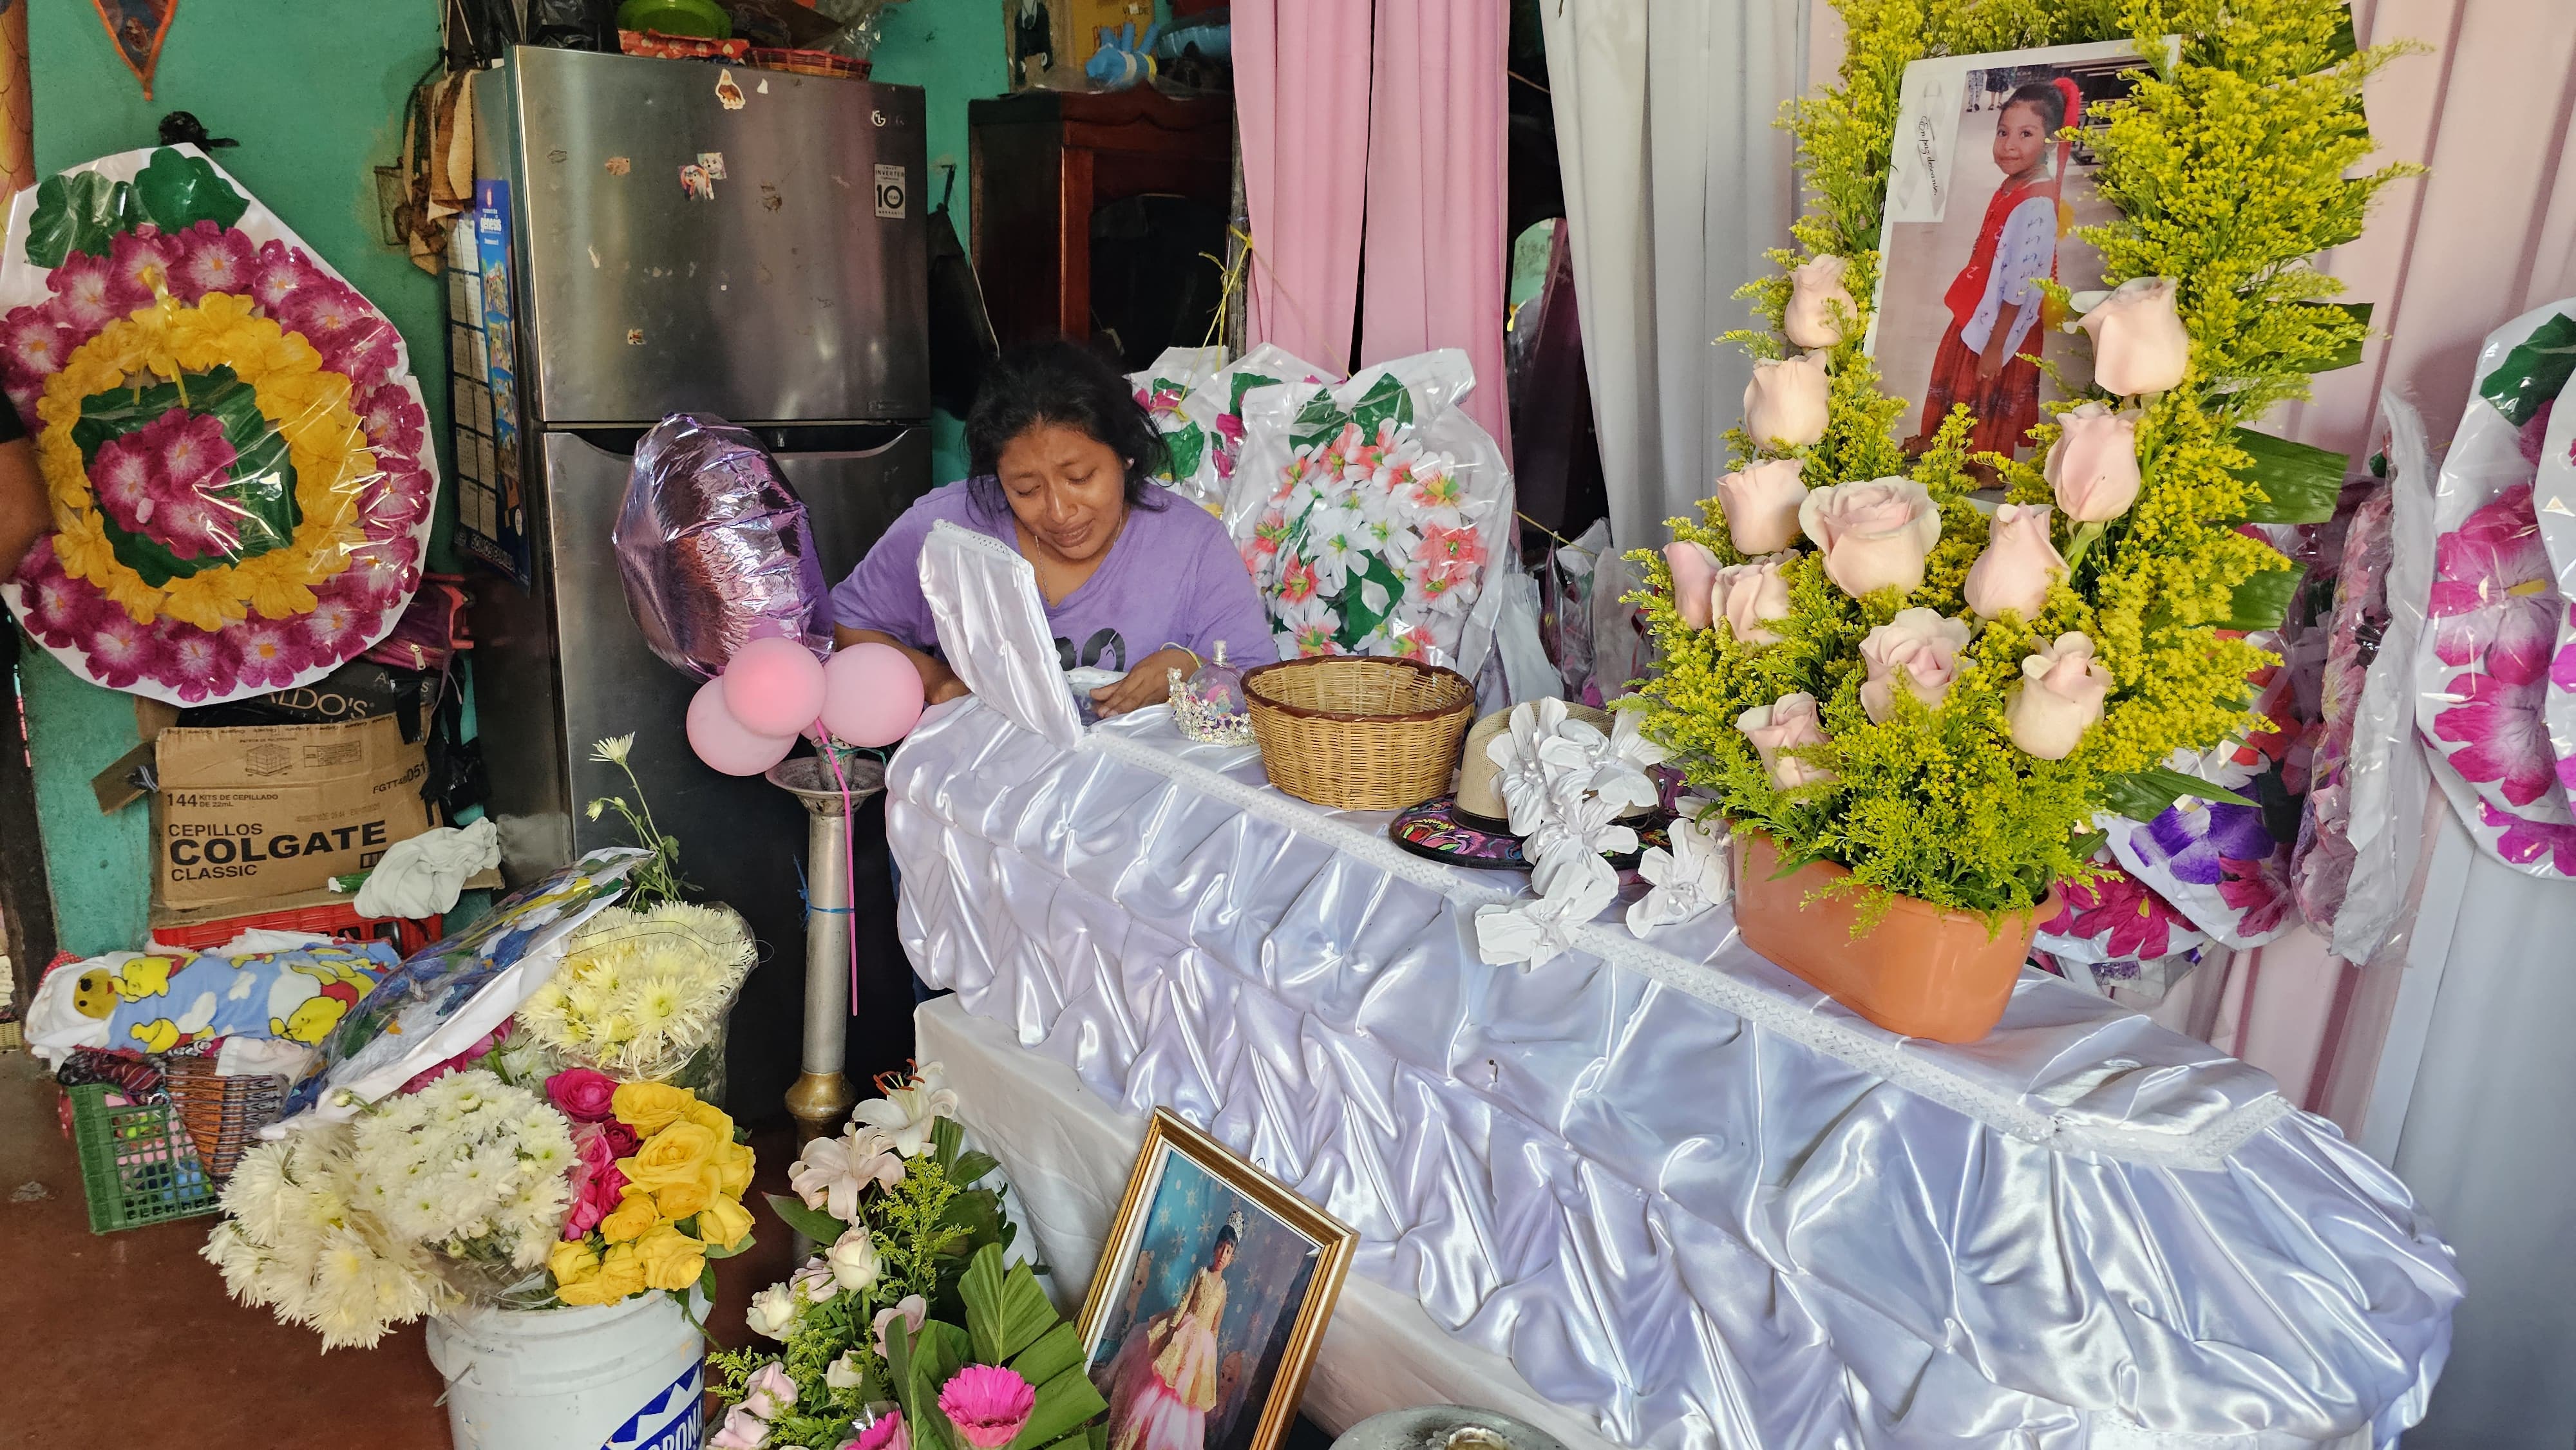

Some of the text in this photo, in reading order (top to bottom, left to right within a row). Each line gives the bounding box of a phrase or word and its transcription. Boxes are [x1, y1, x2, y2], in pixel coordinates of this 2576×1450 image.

[876, 184, 904, 209] 10
[167, 793, 198, 807] 144
[169, 824, 263, 836] CEPILLOS
[170, 819, 387, 866] COLGATE
[171, 864, 258, 881] CLASSIC
